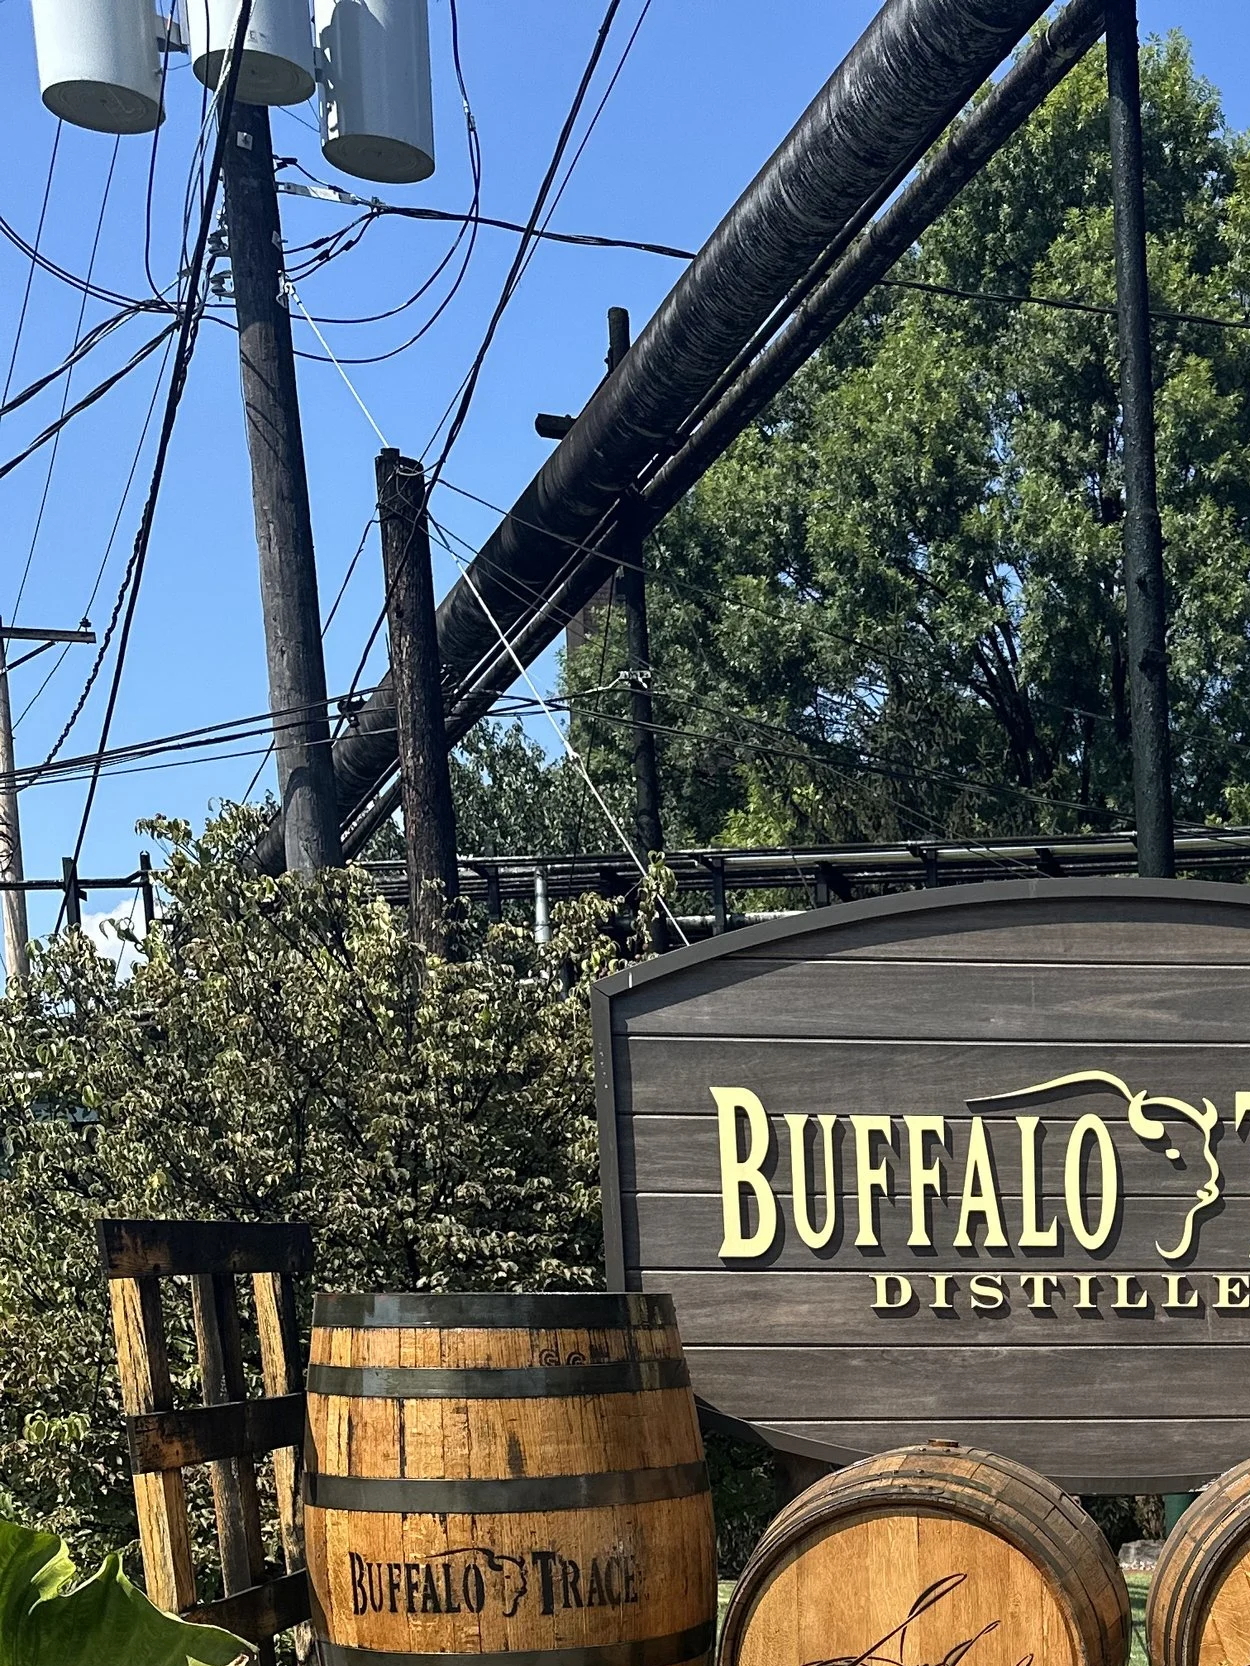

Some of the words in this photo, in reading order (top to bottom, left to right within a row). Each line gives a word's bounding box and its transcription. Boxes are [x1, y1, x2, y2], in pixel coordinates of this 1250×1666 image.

[709, 1087, 1118, 1259] BUFFALO
[349, 1551, 486, 1616] BUFFALO
[531, 1551, 638, 1616] TRACE
